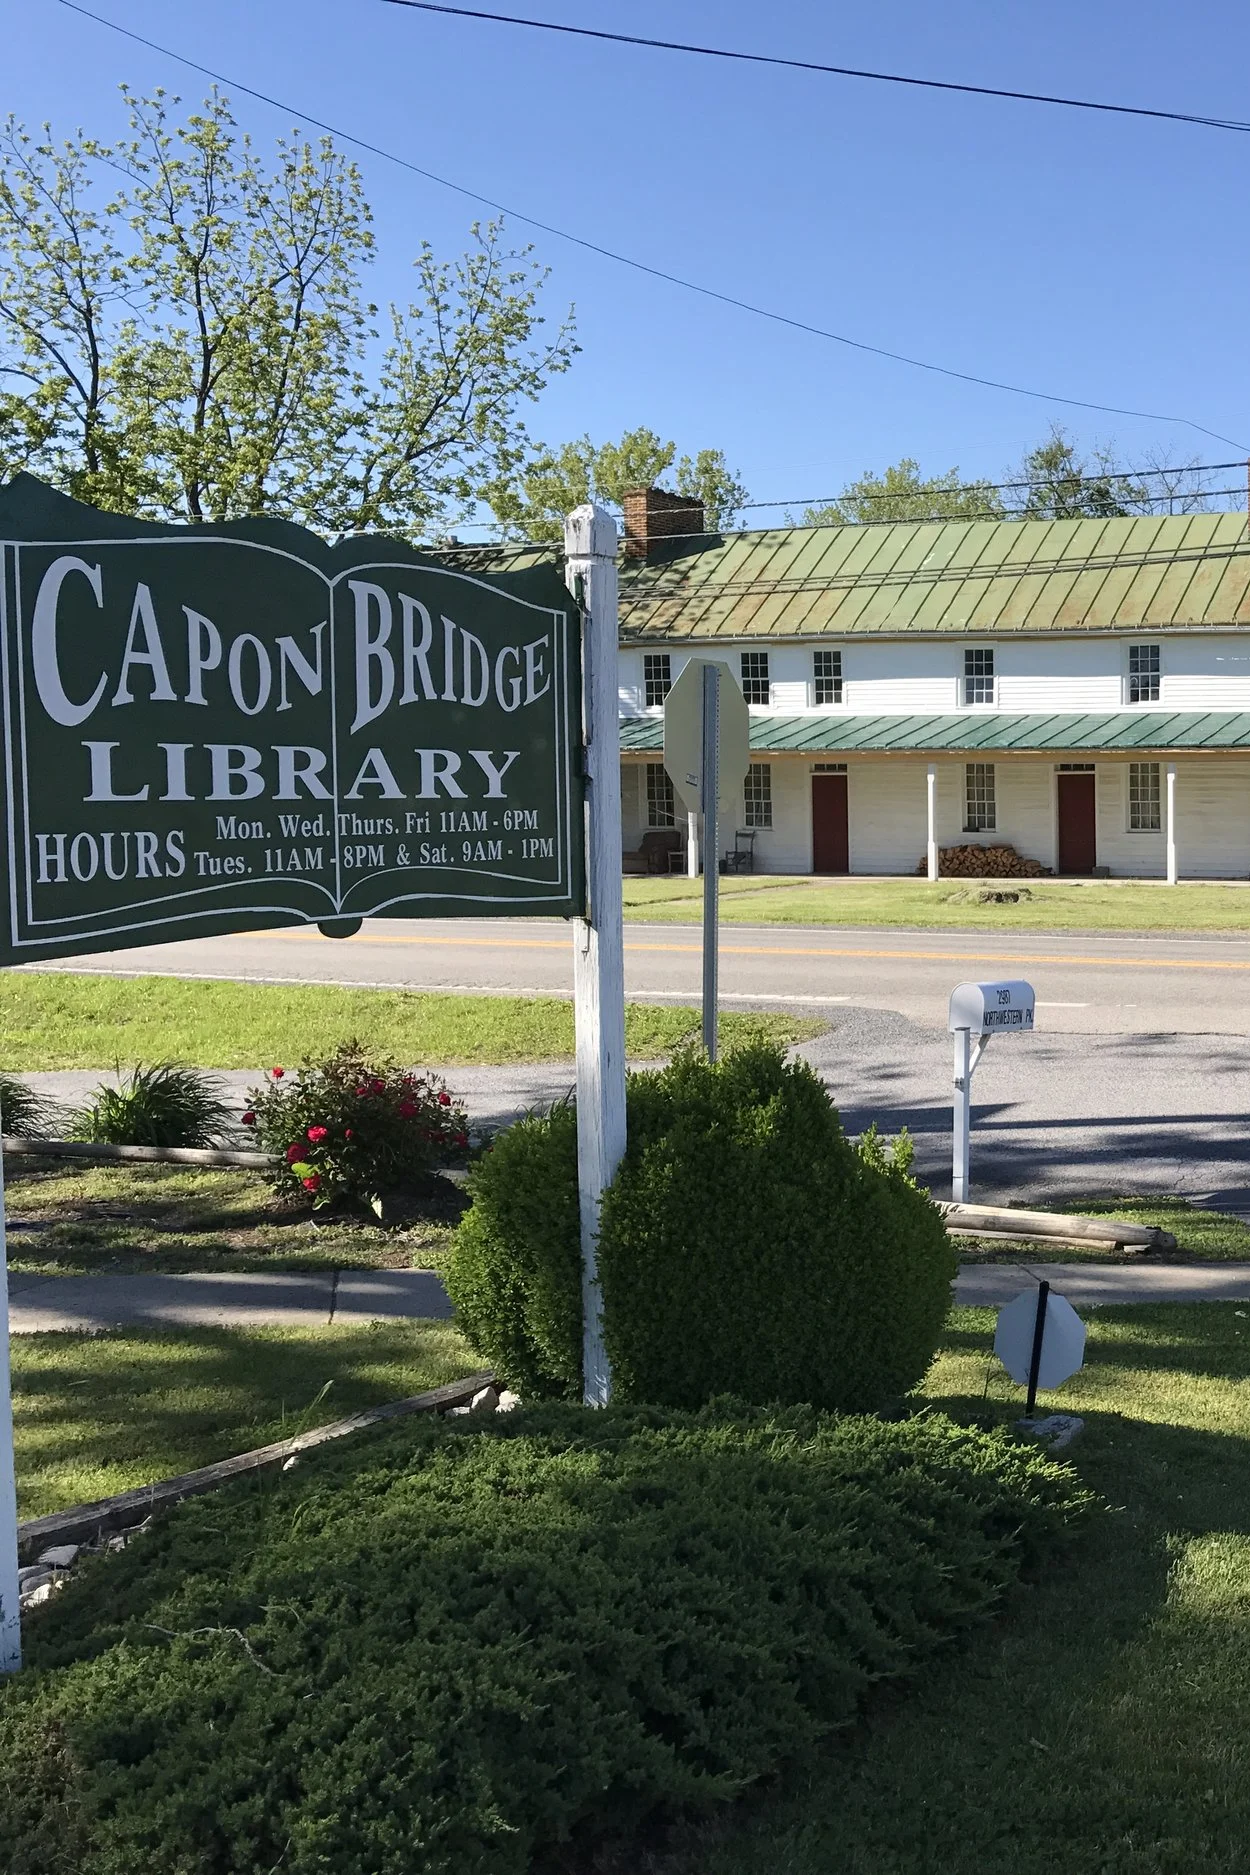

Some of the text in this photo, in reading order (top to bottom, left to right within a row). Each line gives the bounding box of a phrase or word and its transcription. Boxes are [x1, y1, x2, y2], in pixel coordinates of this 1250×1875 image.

[32, 556, 551, 735] CAPON BRIDGE
[80, 741, 521, 802] LIBRARY
[215, 815, 272, 840] Mon.
[278, 813, 331, 838] Wed.
[337, 812, 400, 836] Thurs.
[404, 811, 431, 835] Fri
[439, 810, 488, 833] 11AM
[502, 809, 539, 832] 6PM
[34, 830, 186, 883] HOURS
[193, 851, 253, 877] Tues.
[264, 847, 324, 873] 11AM
[343, 844, 386, 869] 8PM
[396, 843, 411, 866] &
[419, 842, 455, 865] Sat.
[461, 839, 503, 862] 9AM
[521, 837, 555, 860] 1PM
[983, 1009, 1023, 1026] NORTHWESTERN
